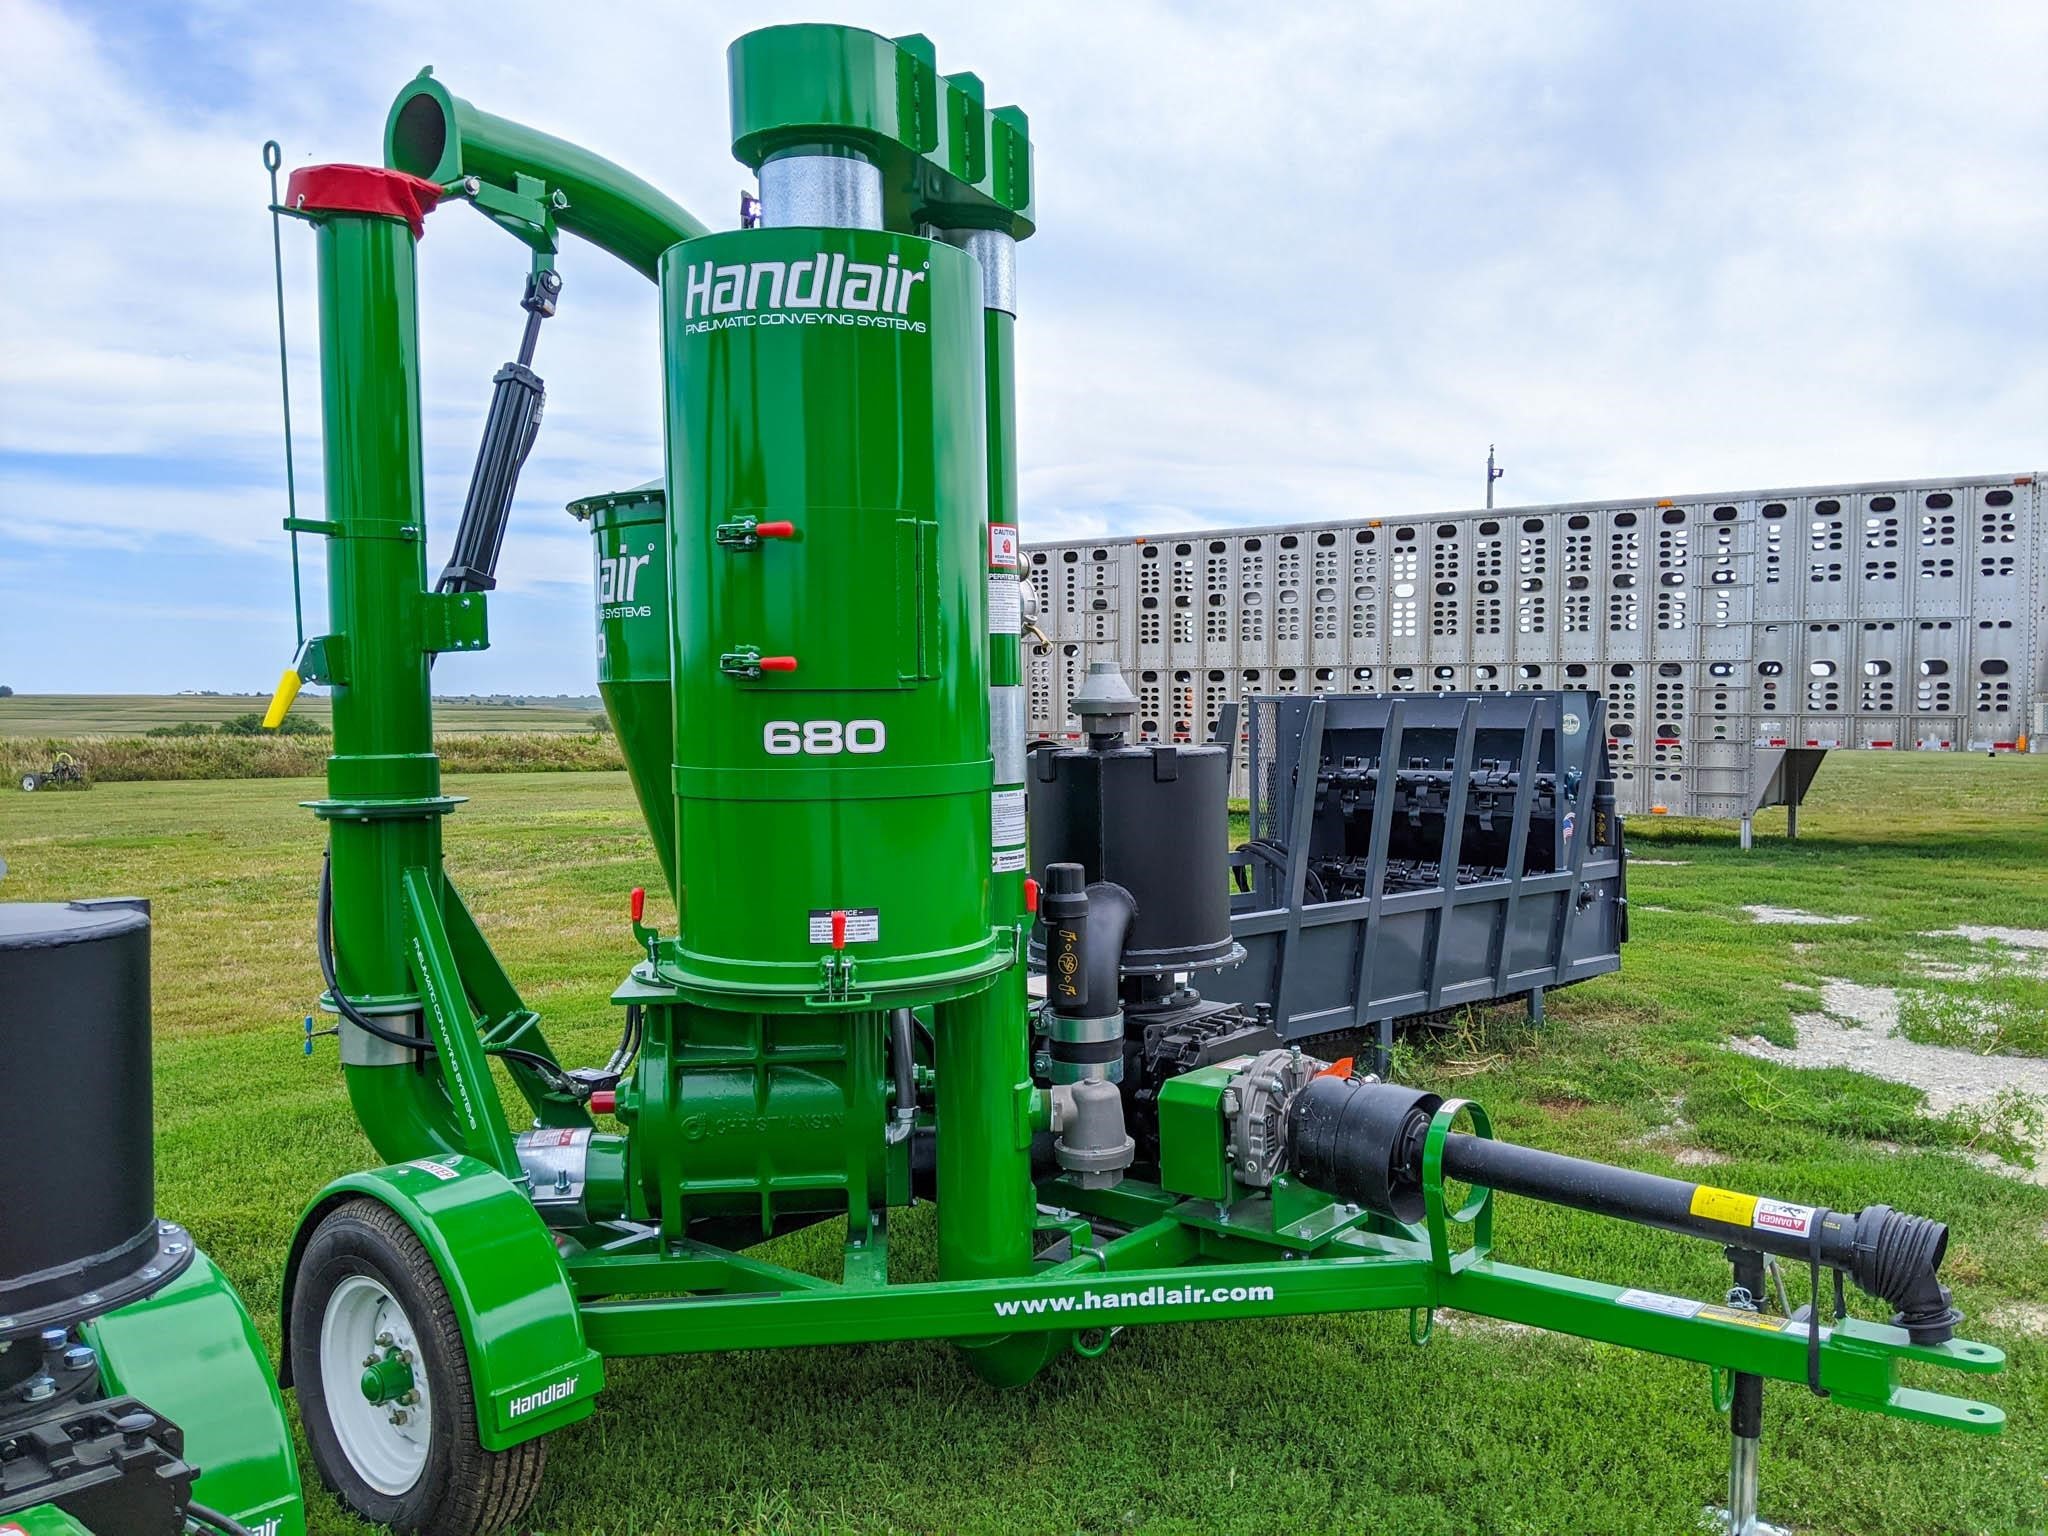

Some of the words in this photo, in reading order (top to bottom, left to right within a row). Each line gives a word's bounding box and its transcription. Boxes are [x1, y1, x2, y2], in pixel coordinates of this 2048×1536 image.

[685, 252, 925, 320] Handlair
[685, 314, 757, 336] PNEUMATIC
[760, 313, 854, 326] CONVEYING
[857, 316, 926, 333] SYSTEMS
[605, 606, 652, 619] SYSTEMS
[763, 719, 886, 755] 680
[412, 936, 437, 1003] PNEUMATIC
[433, 1003, 459, 1073] CONVEYING
[455, 1072, 477, 1131] SYSTEMS
[1759, 1213, 1793, 1228] DANGER
[993, 1285, 1274, 1317] www.handlair.com
[510, 1375, 579, 1418] Handlair
